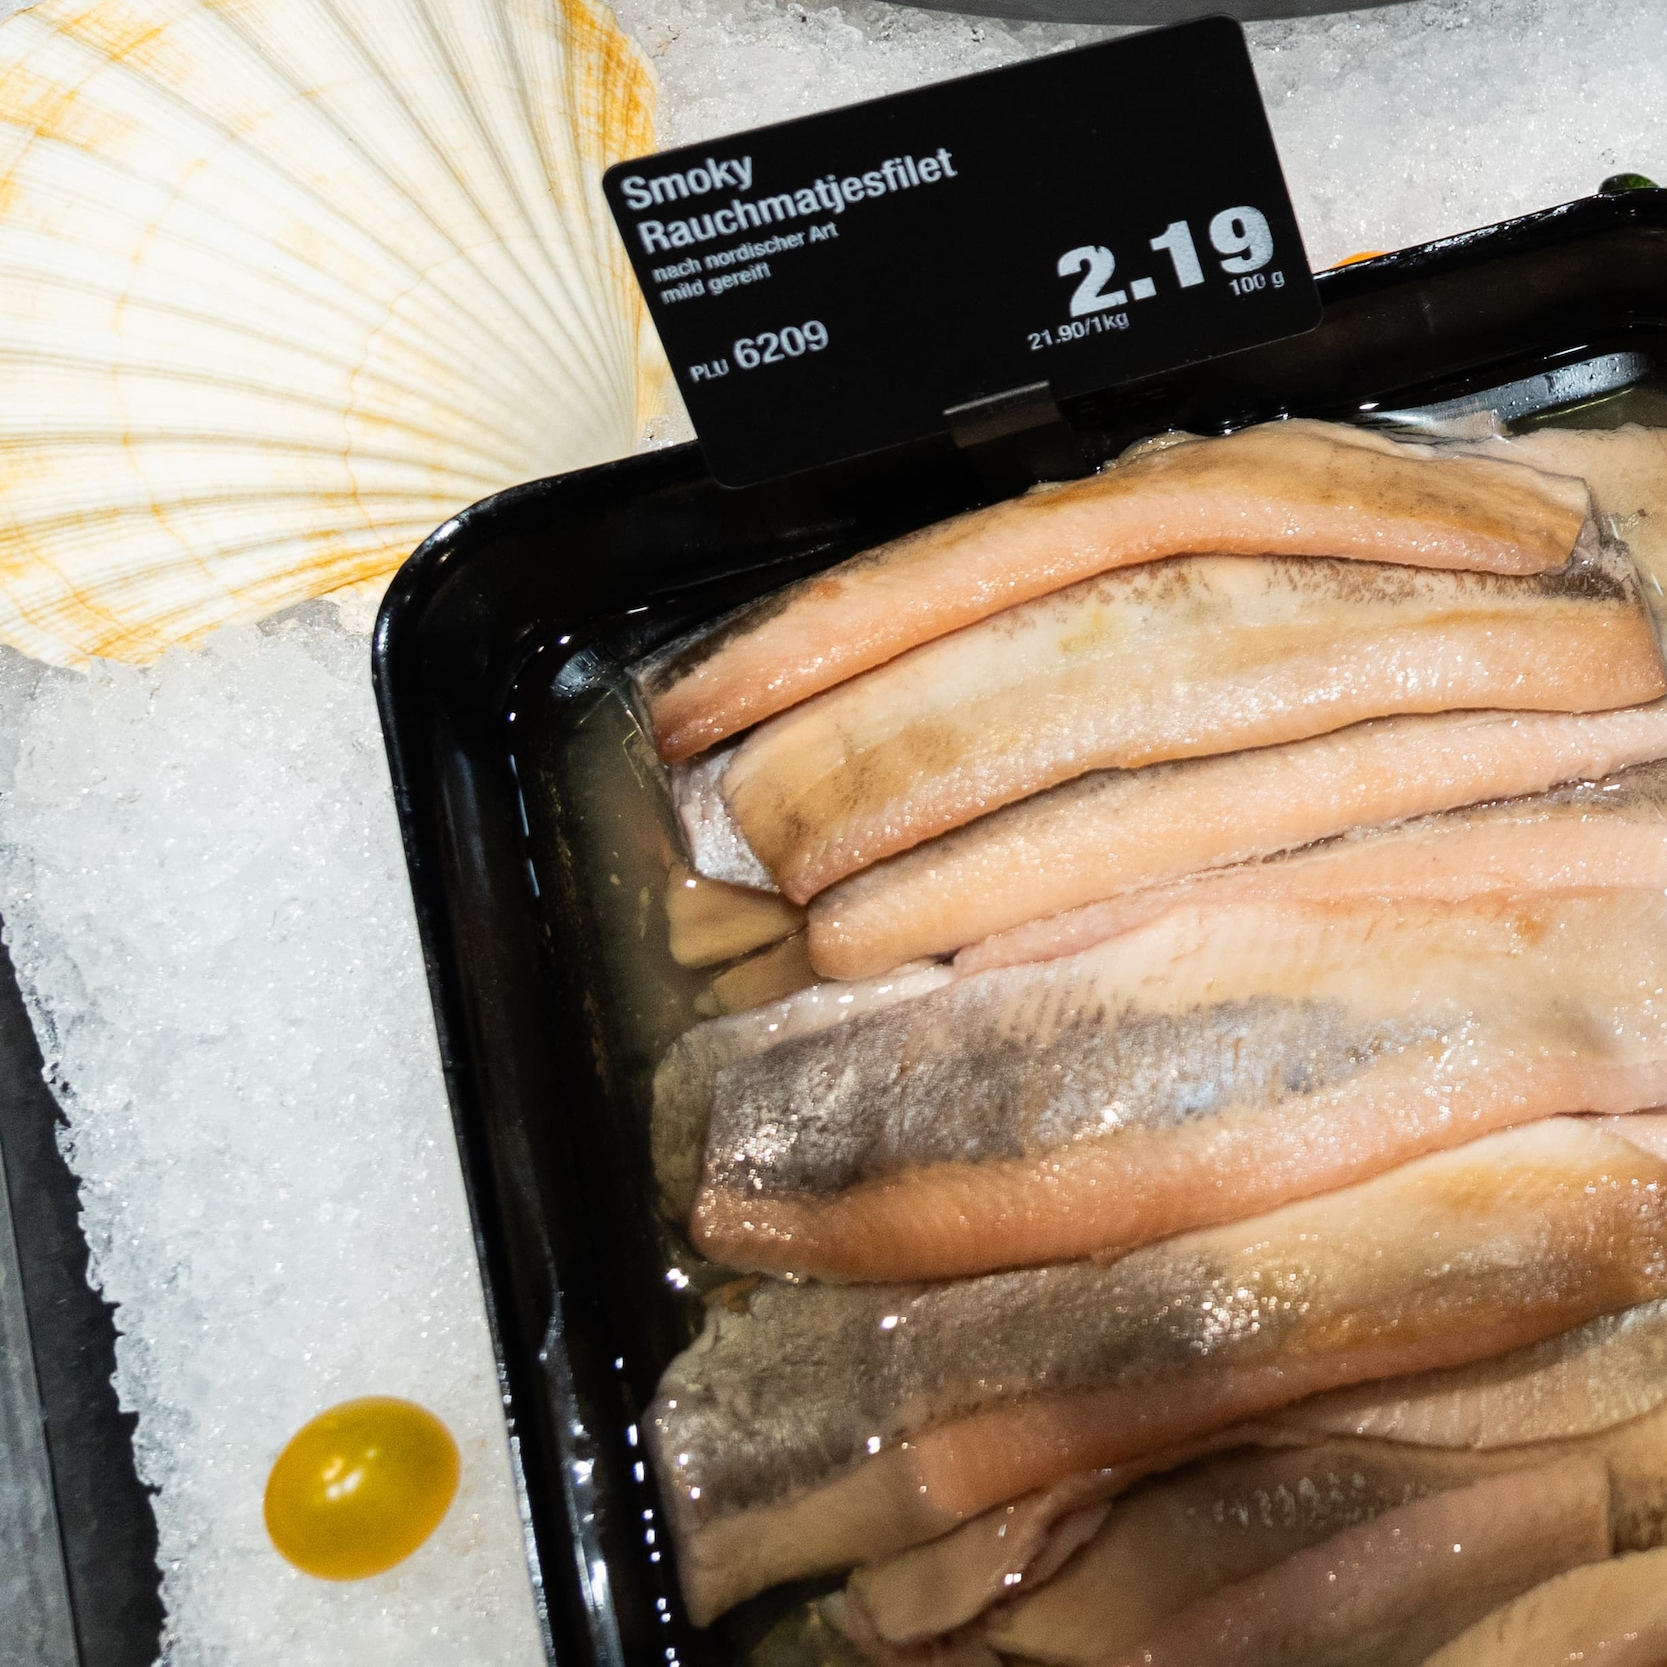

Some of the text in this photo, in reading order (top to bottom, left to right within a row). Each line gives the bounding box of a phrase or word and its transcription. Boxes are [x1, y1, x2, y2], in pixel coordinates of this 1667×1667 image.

[621, 156, 752, 209] Smoky
[638, 148, 957, 253] Rauchmatjesfilet
[653, 222, 838, 282] nach nordischer Art
[1057, 206, 1273, 317] 2.19
[661, 262, 771, 303] mild gereift
[1230, 271, 1285, 295] 100 g
[690, 321, 828, 381] PLU 6209
[1028, 313, 1129, 350] 21.90/1kg
